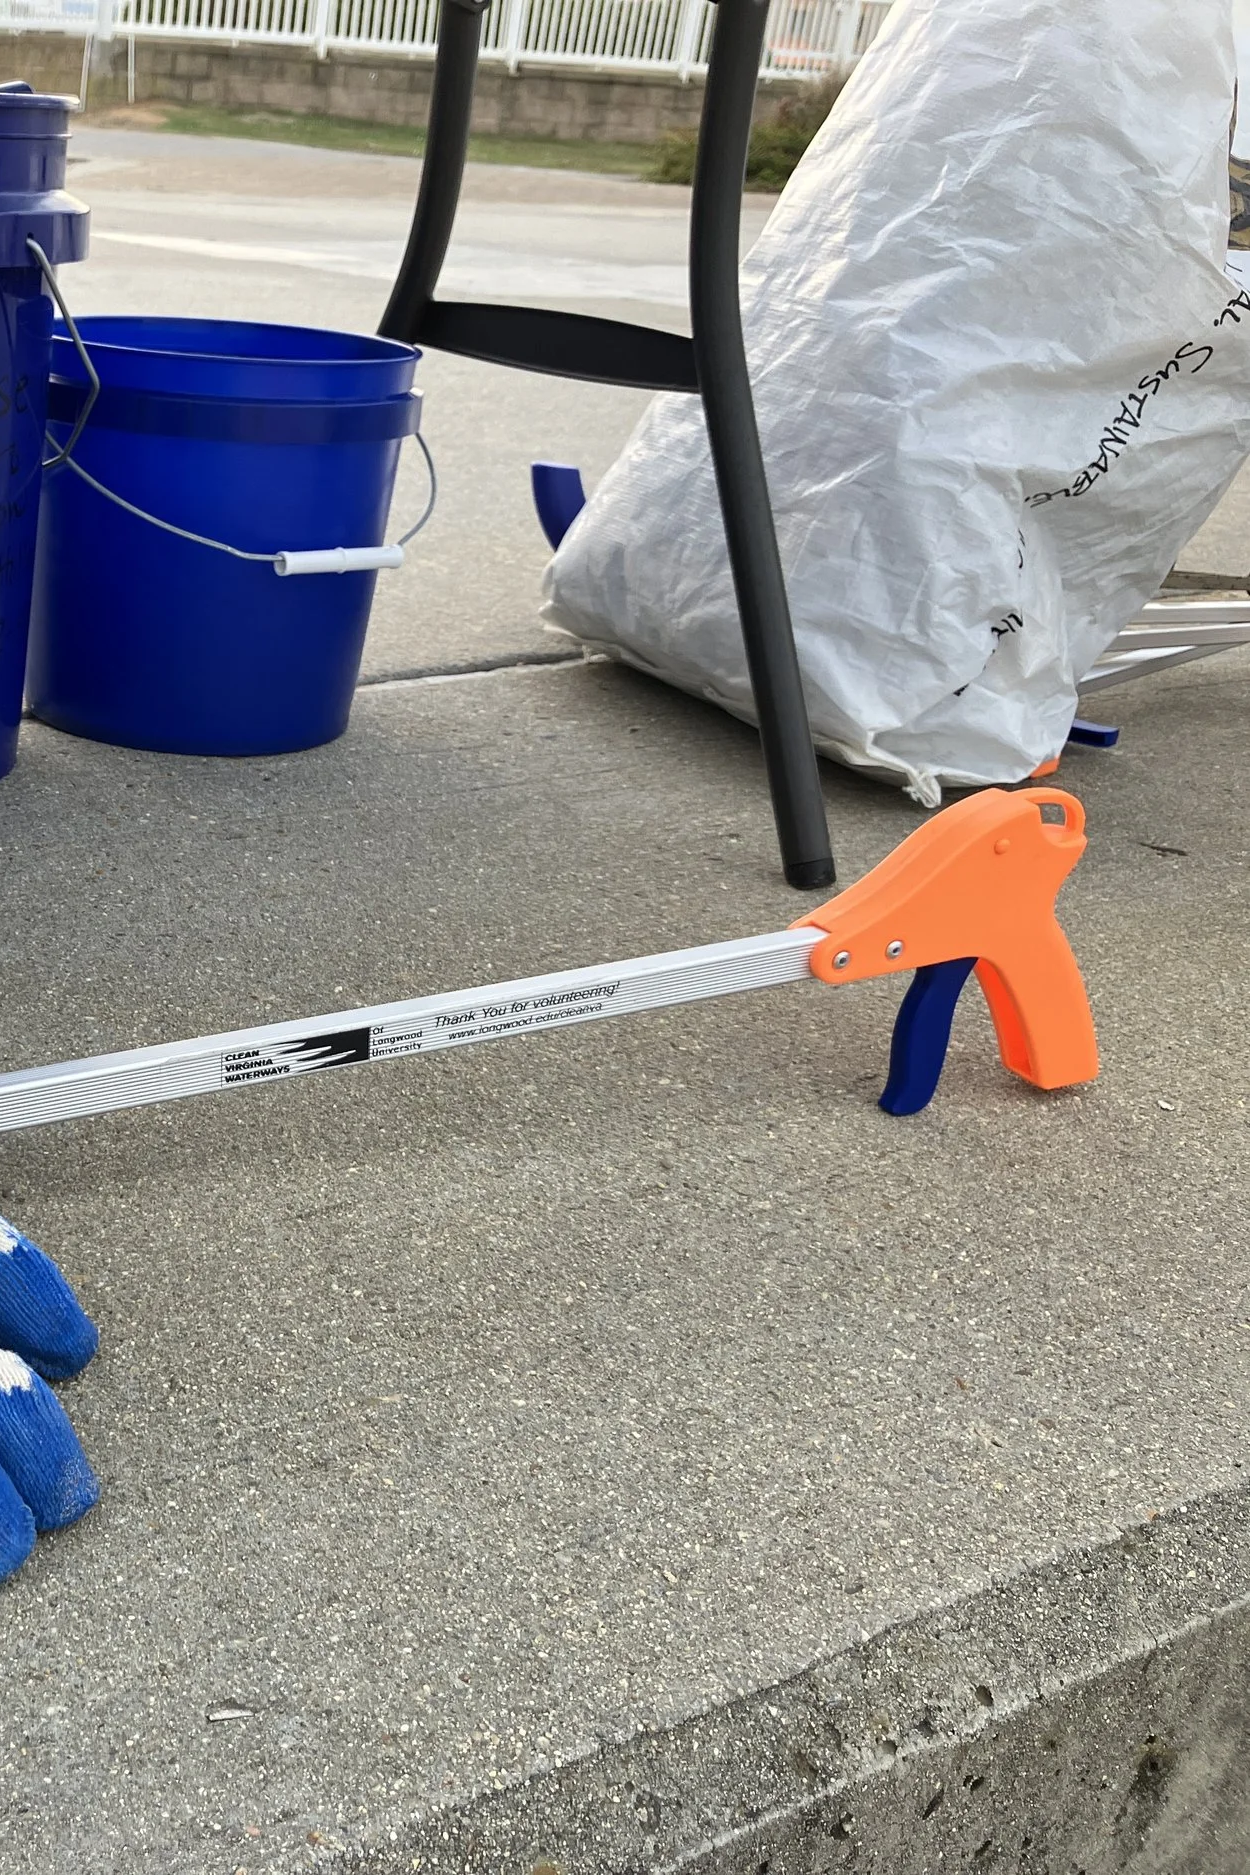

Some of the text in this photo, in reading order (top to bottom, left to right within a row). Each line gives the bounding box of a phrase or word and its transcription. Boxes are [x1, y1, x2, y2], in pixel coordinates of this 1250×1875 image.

[434, 981, 621, 1028] Thank You for volunteering!
[372, 1026, 384, 1036] Of
[372, 1030, 423, 1046] Longwood
[225, 1050, 260, 1062] CLEAN
[371, 1042, 423, 1058] University
[225, 1058, 273, 1072] VIRGINIA
[225, 1065, 290, 1083] WATERWAYS
